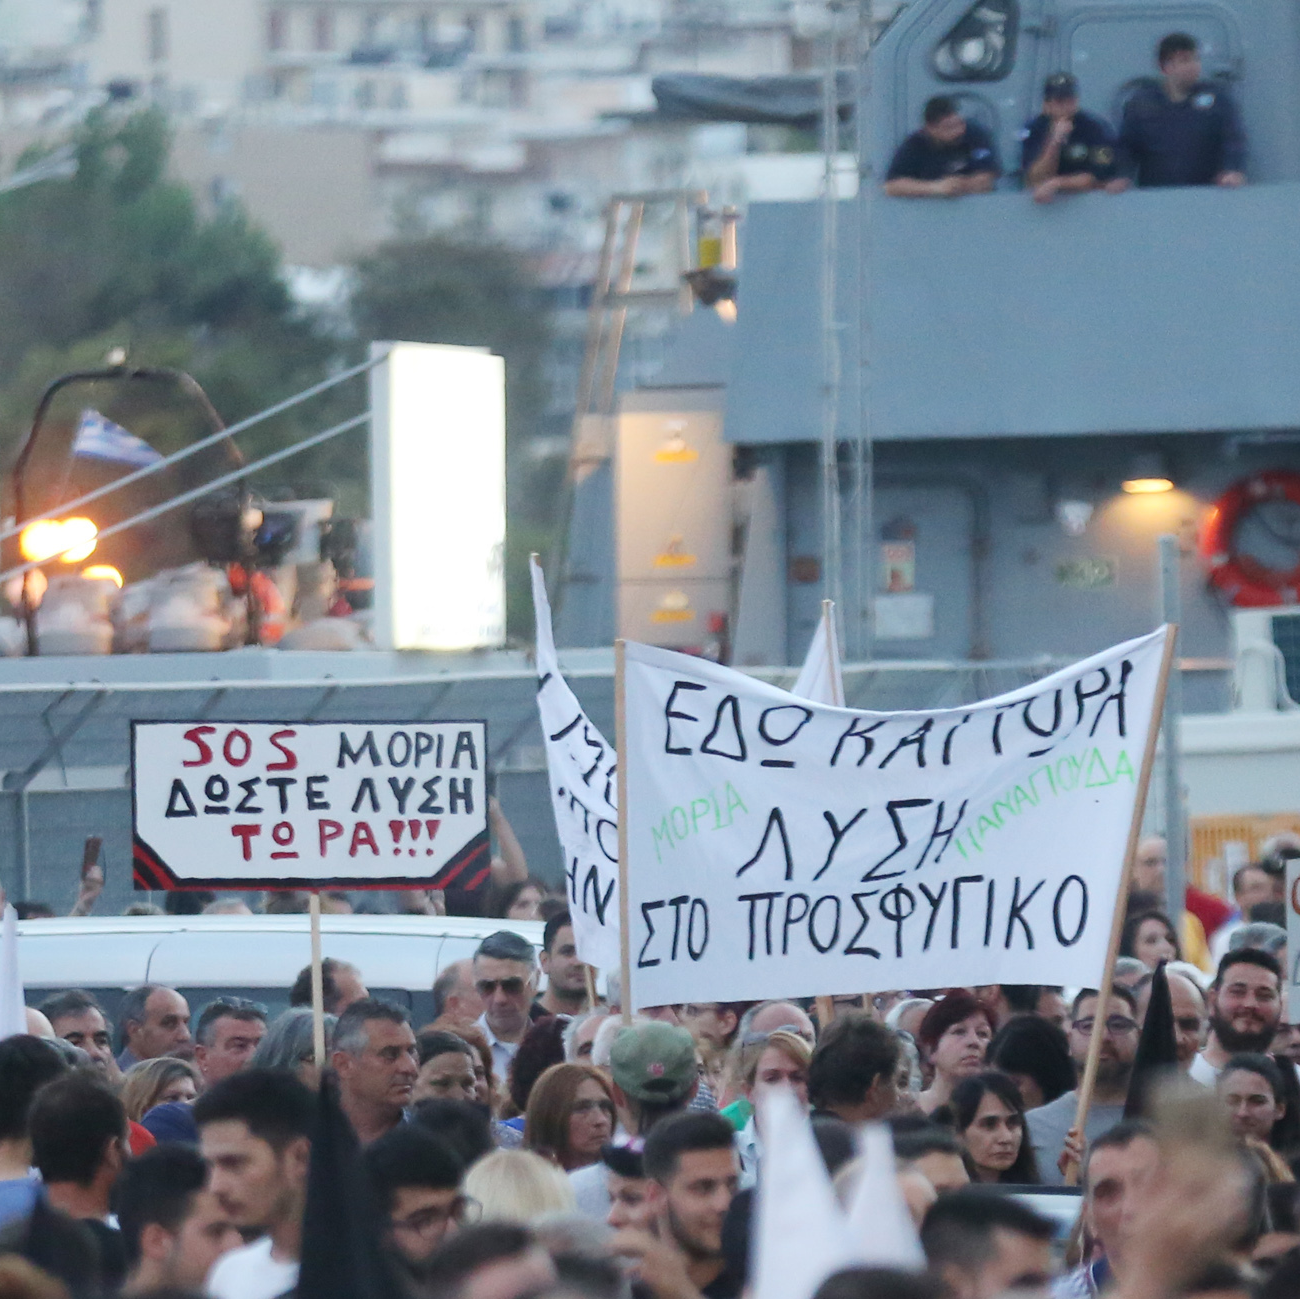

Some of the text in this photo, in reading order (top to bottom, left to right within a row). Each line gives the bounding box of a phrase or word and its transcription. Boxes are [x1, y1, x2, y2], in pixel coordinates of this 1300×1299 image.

[182, 725, 478, 771] SOS ΜΟΡΙΑ
[665, 680, 813, 769] ΕΔΩ
[830, 711, 974, 769] ΚΑΙ
[165, 773, 475, 818] ΔΩΣΤΕ ΛΥΣΗ
[651, 780, 748, 864] ΜΟΡΙΑ
[735, 797, 969, 882] ΛΥΣΗ
[637, 874, 1089, 968] ΣΤΟ ΠΡΟΣΦΥΓΙΚΟ
